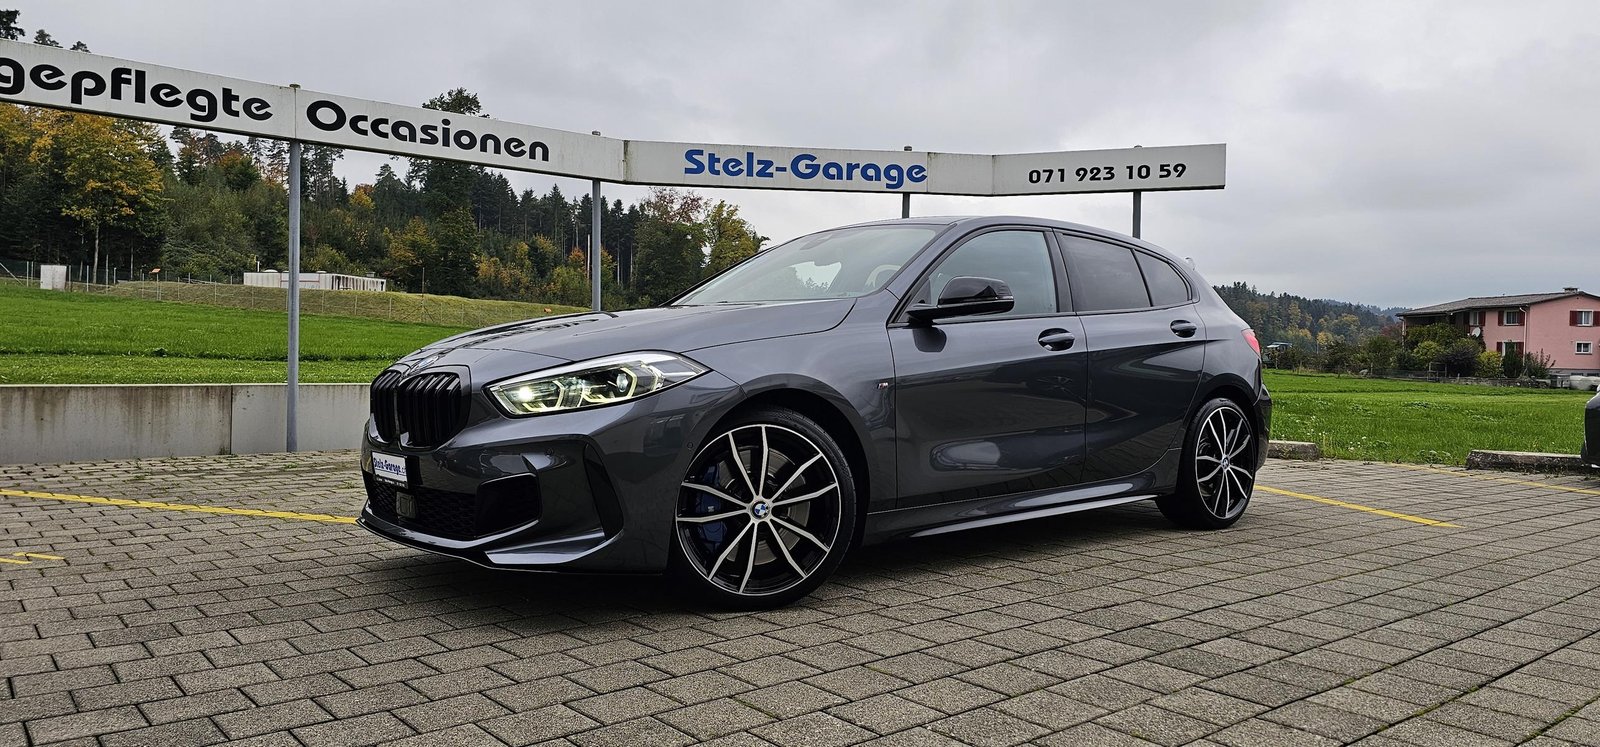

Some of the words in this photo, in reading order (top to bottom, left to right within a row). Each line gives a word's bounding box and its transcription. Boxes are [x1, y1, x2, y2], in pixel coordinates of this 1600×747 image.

[0, 58, 273, 123] gepflegte
[307, 100, 550, 162] Occasionen
[684, 148, 928, 190] Stelz-Garage
[1028, 168, 1065, 184] 071
[1075, 166, 1116, 182] 923
[1125, 164, 1151, 181] 10
[1158, 162, 1187, 179] 59
